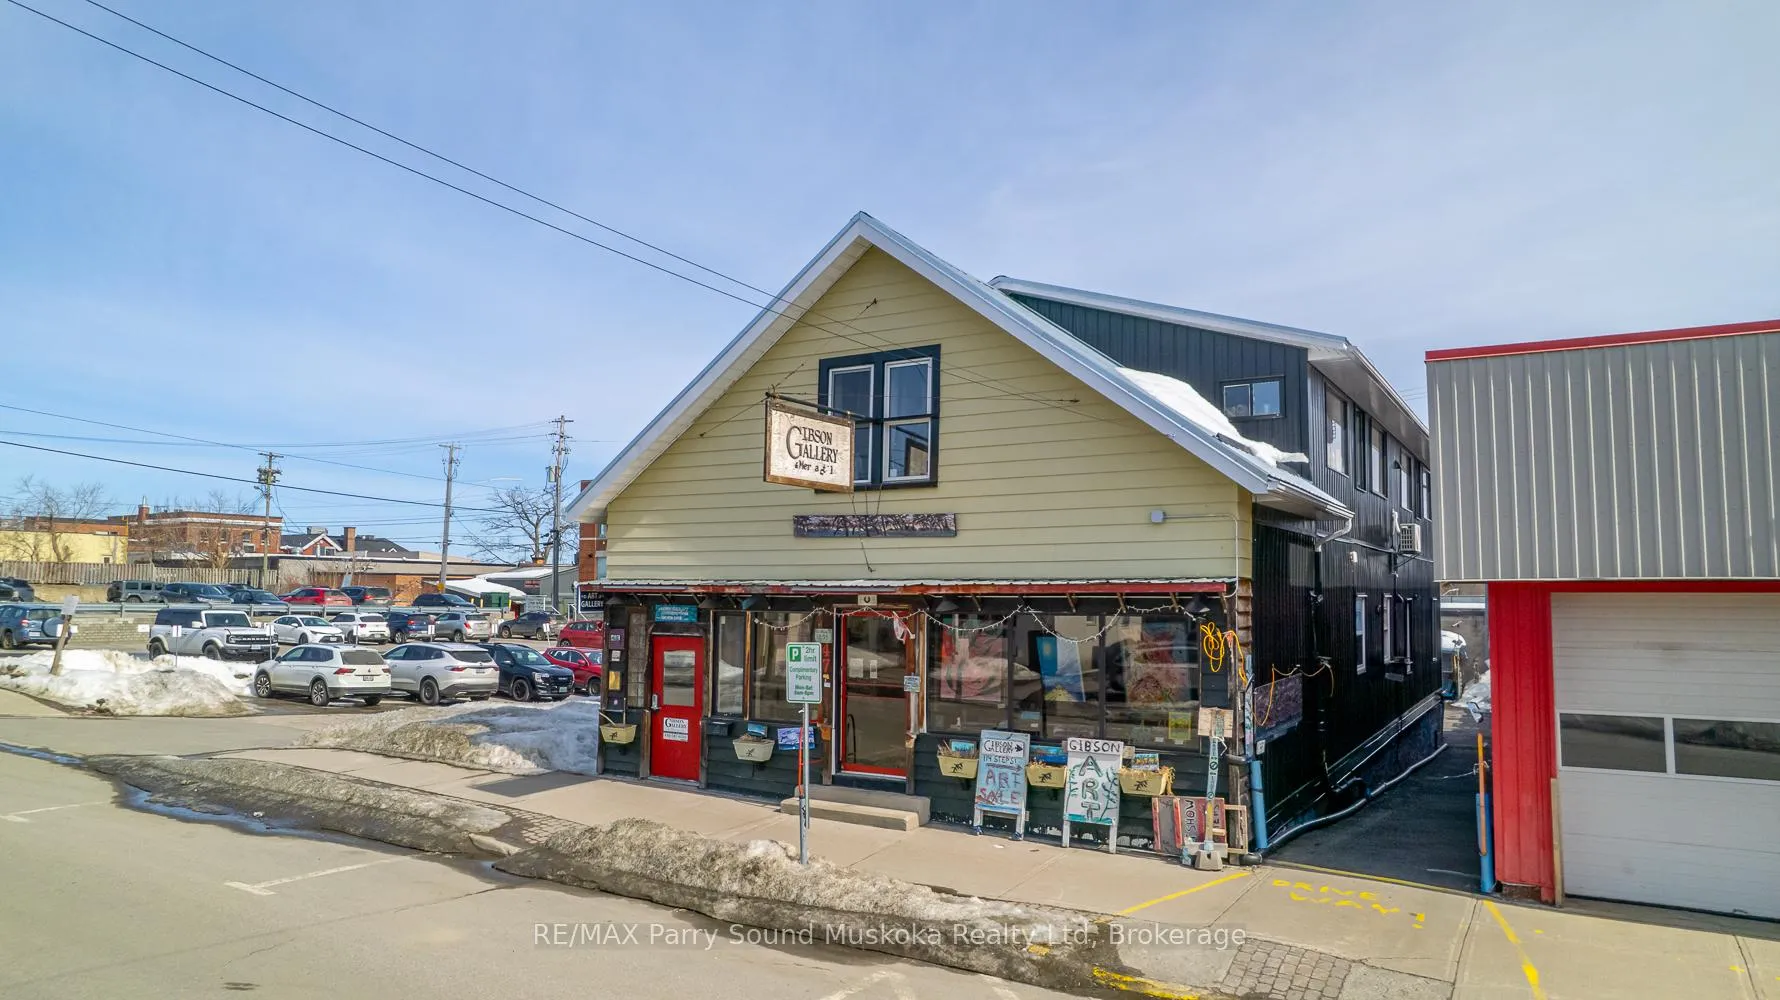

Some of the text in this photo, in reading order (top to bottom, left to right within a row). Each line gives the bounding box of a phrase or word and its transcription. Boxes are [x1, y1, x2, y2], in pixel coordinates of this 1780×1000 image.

[786, 426, 832, 446] GIBSON
[786, 442, 838, 463] GALLERY
[1069, 740, 1120, 752] GIBSON
[986, 768, 1021, 788] ART
[980, 787, 1020, 804] SALE
